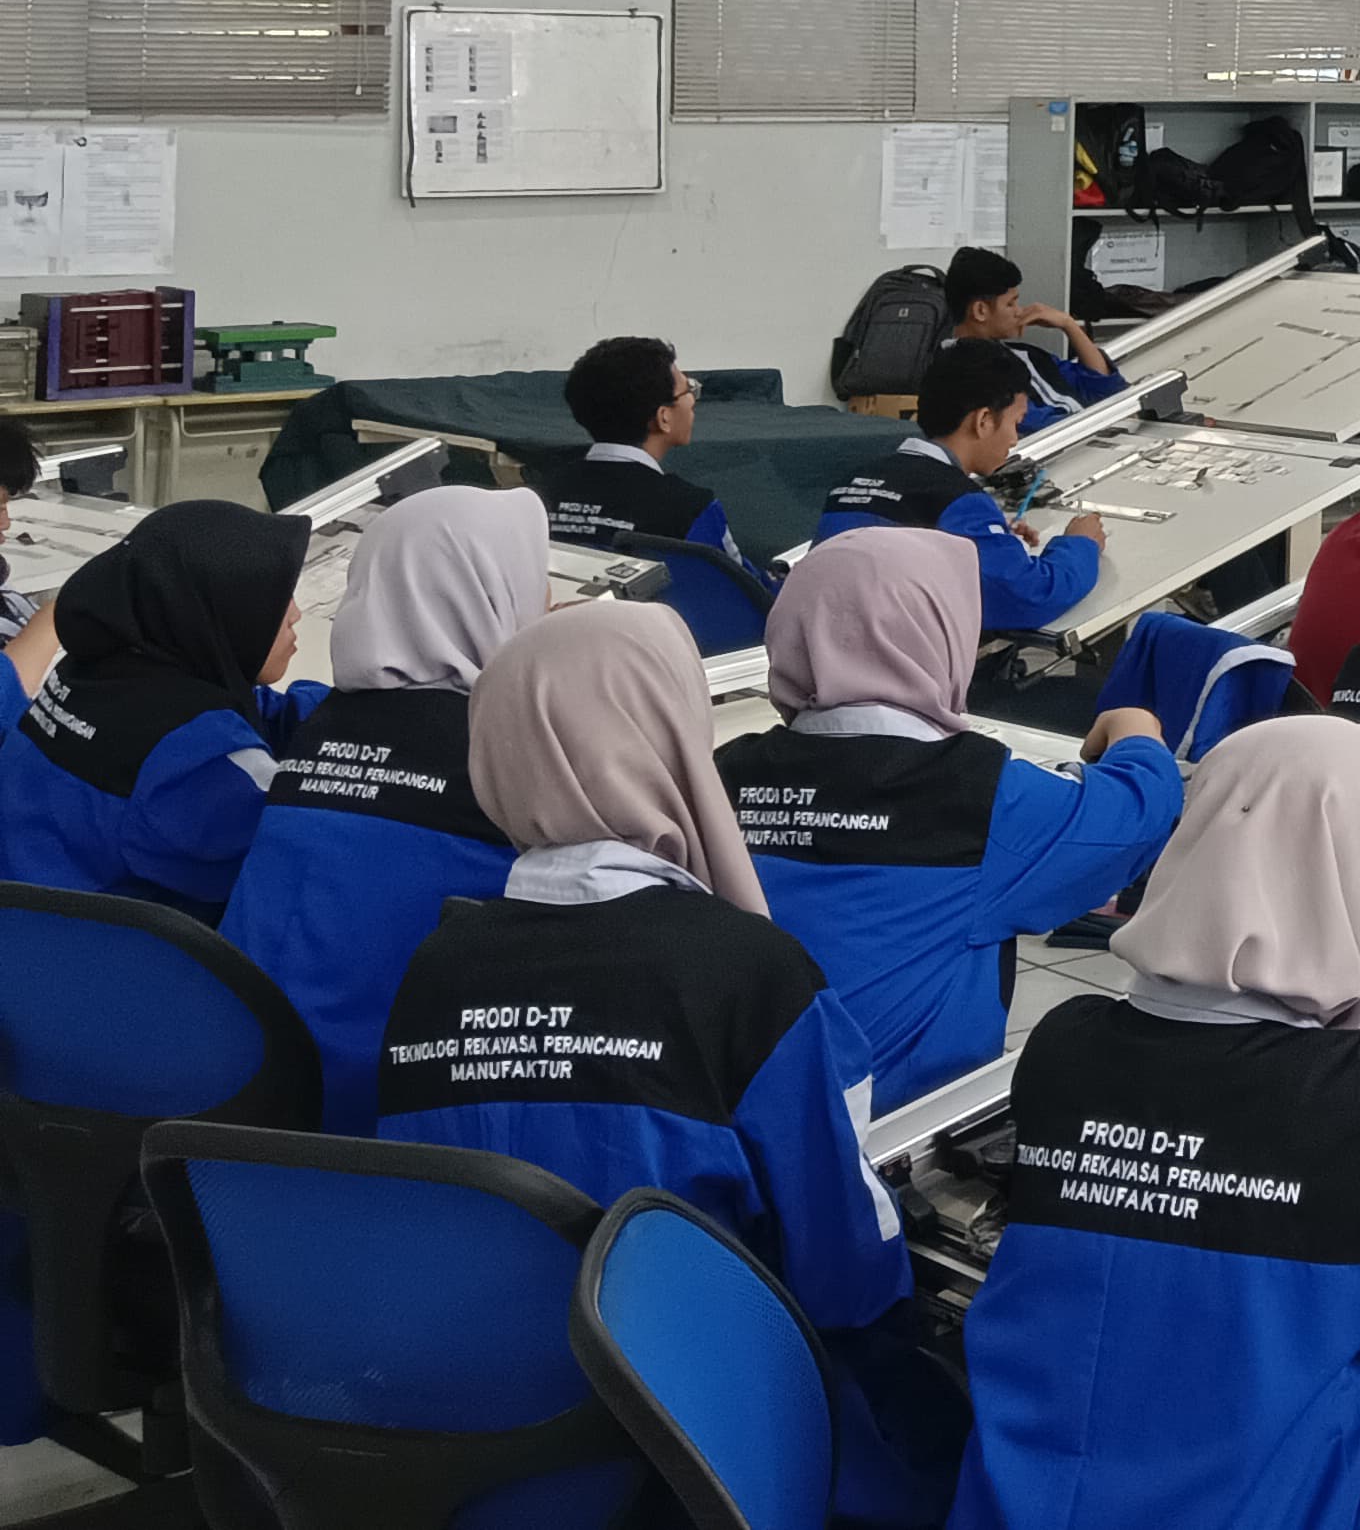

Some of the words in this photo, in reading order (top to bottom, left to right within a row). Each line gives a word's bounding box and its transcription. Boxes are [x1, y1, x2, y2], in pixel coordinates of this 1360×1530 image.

[317, 741, 358, 760] PRODI
[360, 745, 391, 764] D-IV
[299, 778, 380, 800] MANUFAKTUR
[314, 761, 363, 780] REKAYASA
[364, 767, 446, 794] PERANCANGAN
[738, 787, 780, 804] PRODI
[783, 787, 816, 805] D-IV
[792, 812, 889, 831] PERANCANGAN
[460, 1007, 520, 1030] PRODI
[526, 1006, 572, 1028] D-IV
[390, 1039, 459, 1065] TEKNOLOGI
[464, 1035, 537, 1056] REKAYASA
[543, 1035, 662, 1061] PERANCANGAN
[451, 1059, 573, 1082] MANUFAKTUR
[1080, 1120, 1146, 1151] PRODI
[1151, 1131, 1204, 1160] D-IV
[1017, 1144, 1077, 1172] TEKNOLOGI
[1079, 1153, 1160, 1185] REKAYASA
[1166, 1166, 1300, 1205] PERANCANGAN
[1060, 1179, 1199, 1220] MANUFAKTUR
